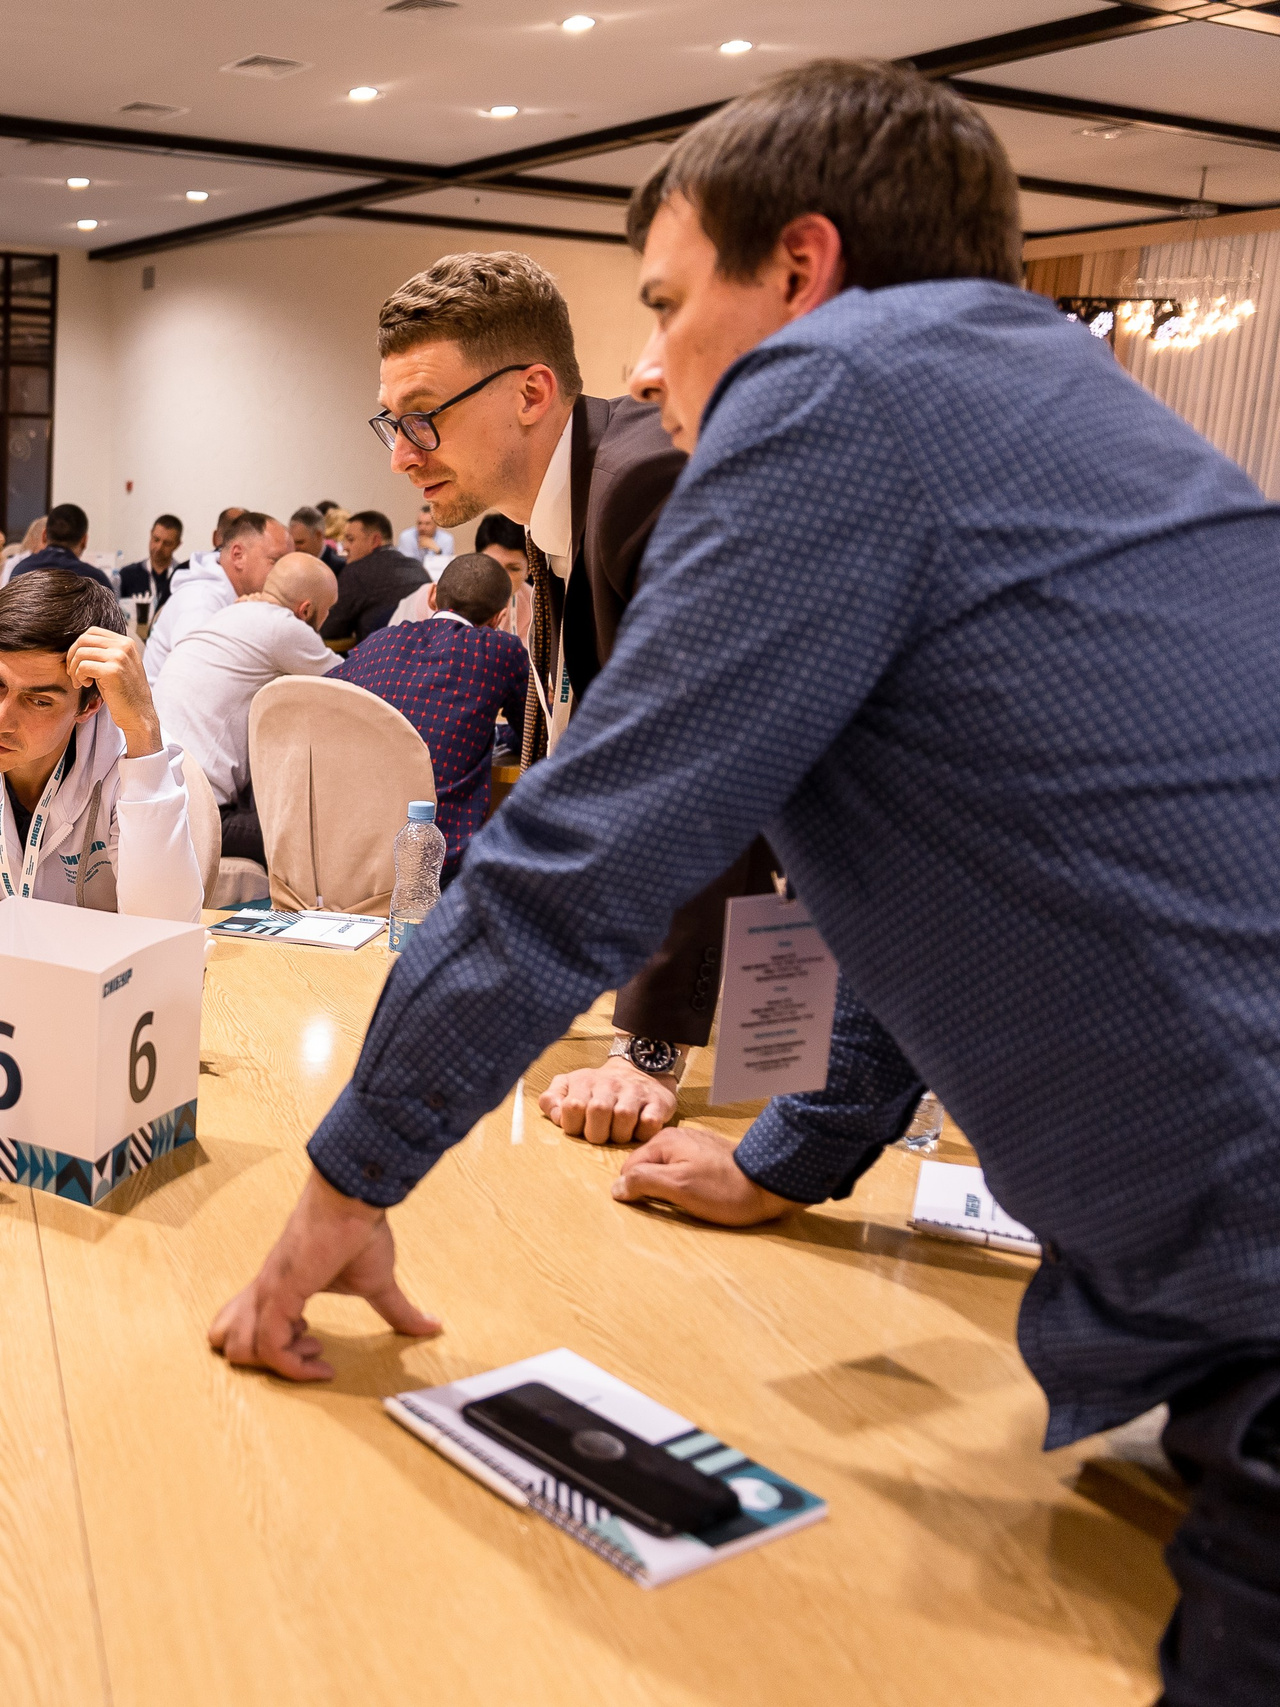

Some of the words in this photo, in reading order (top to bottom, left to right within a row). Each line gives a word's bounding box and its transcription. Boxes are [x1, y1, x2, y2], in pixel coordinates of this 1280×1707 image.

[30, 814, 43, 847] СИБУР
[2, 872, 15, 896] СИБУ
[103, 967, 133, 998] СИБУР
[129, 1011, 157, 1104] 6
